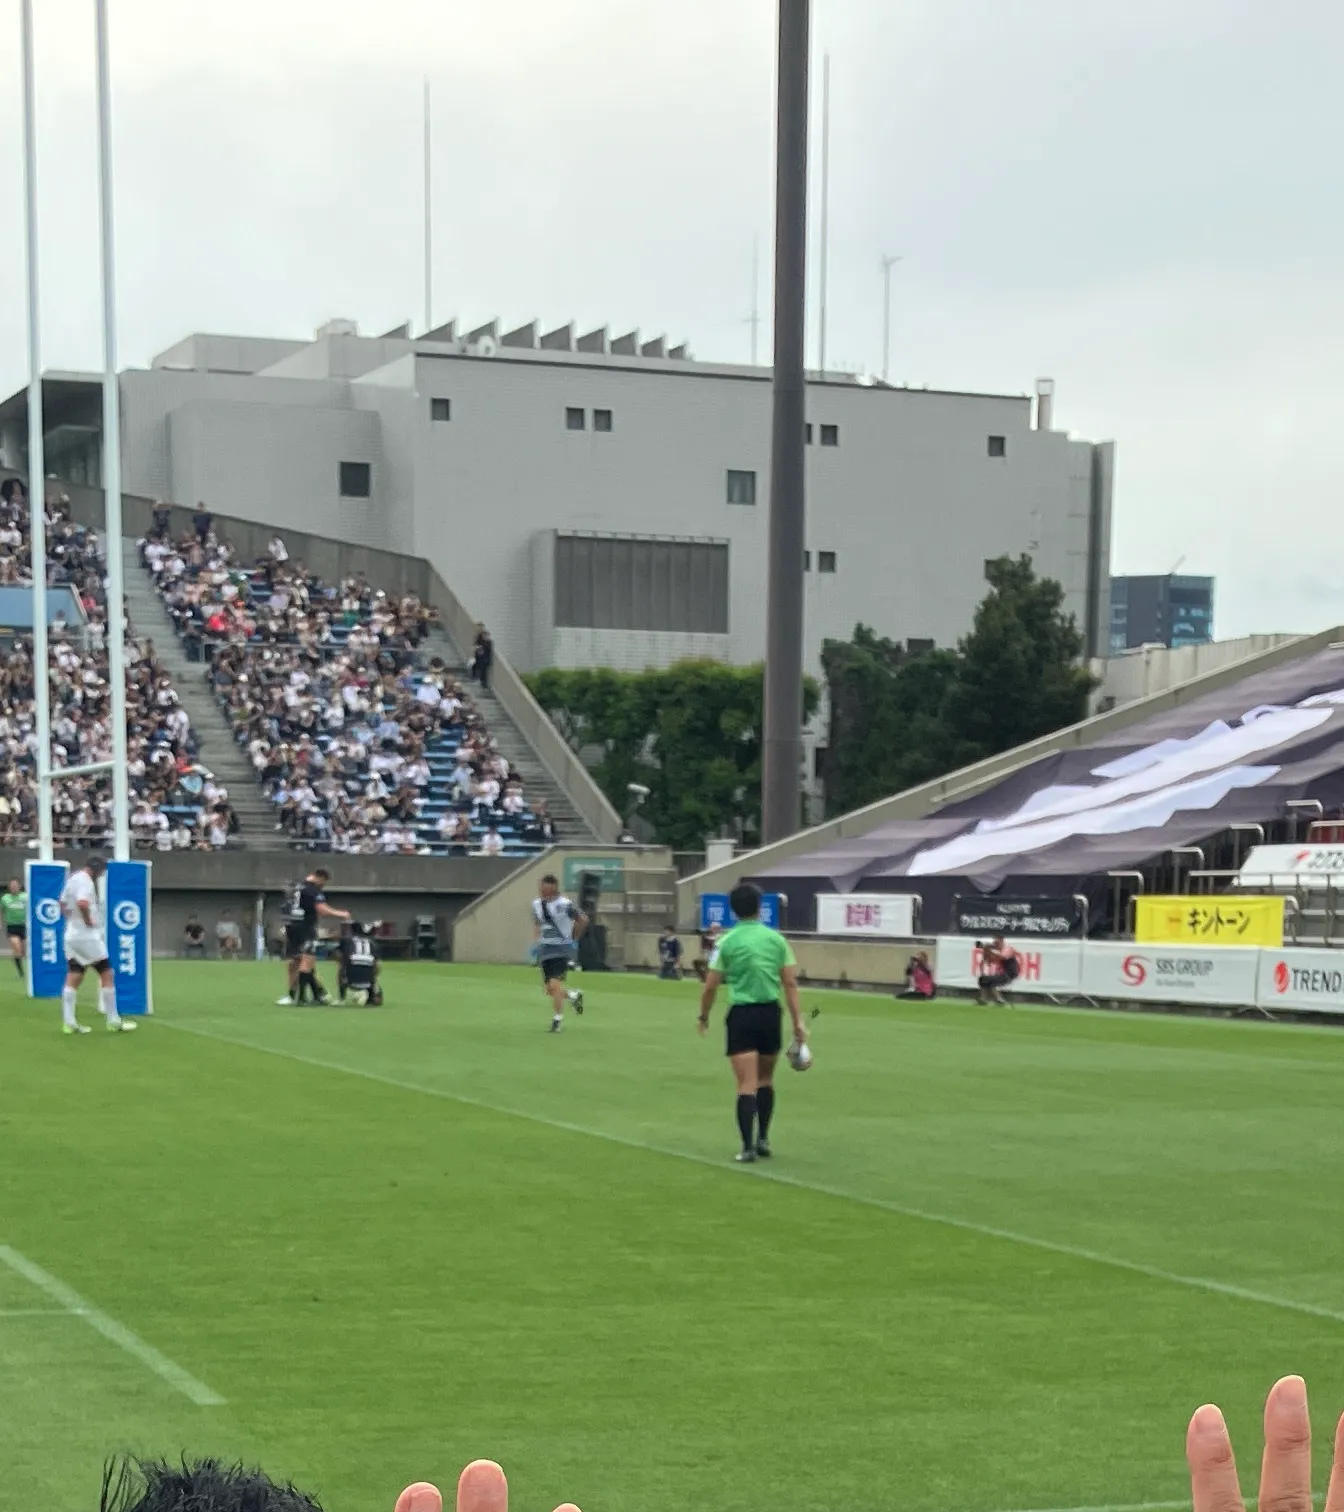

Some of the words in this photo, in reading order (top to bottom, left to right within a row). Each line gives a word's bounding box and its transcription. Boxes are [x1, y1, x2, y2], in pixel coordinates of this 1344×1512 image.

[1187, 906, 1251, 935] キントーン
[118, 934, 137, 976] NTT
[1292, 967, 1343, 994] TREND
